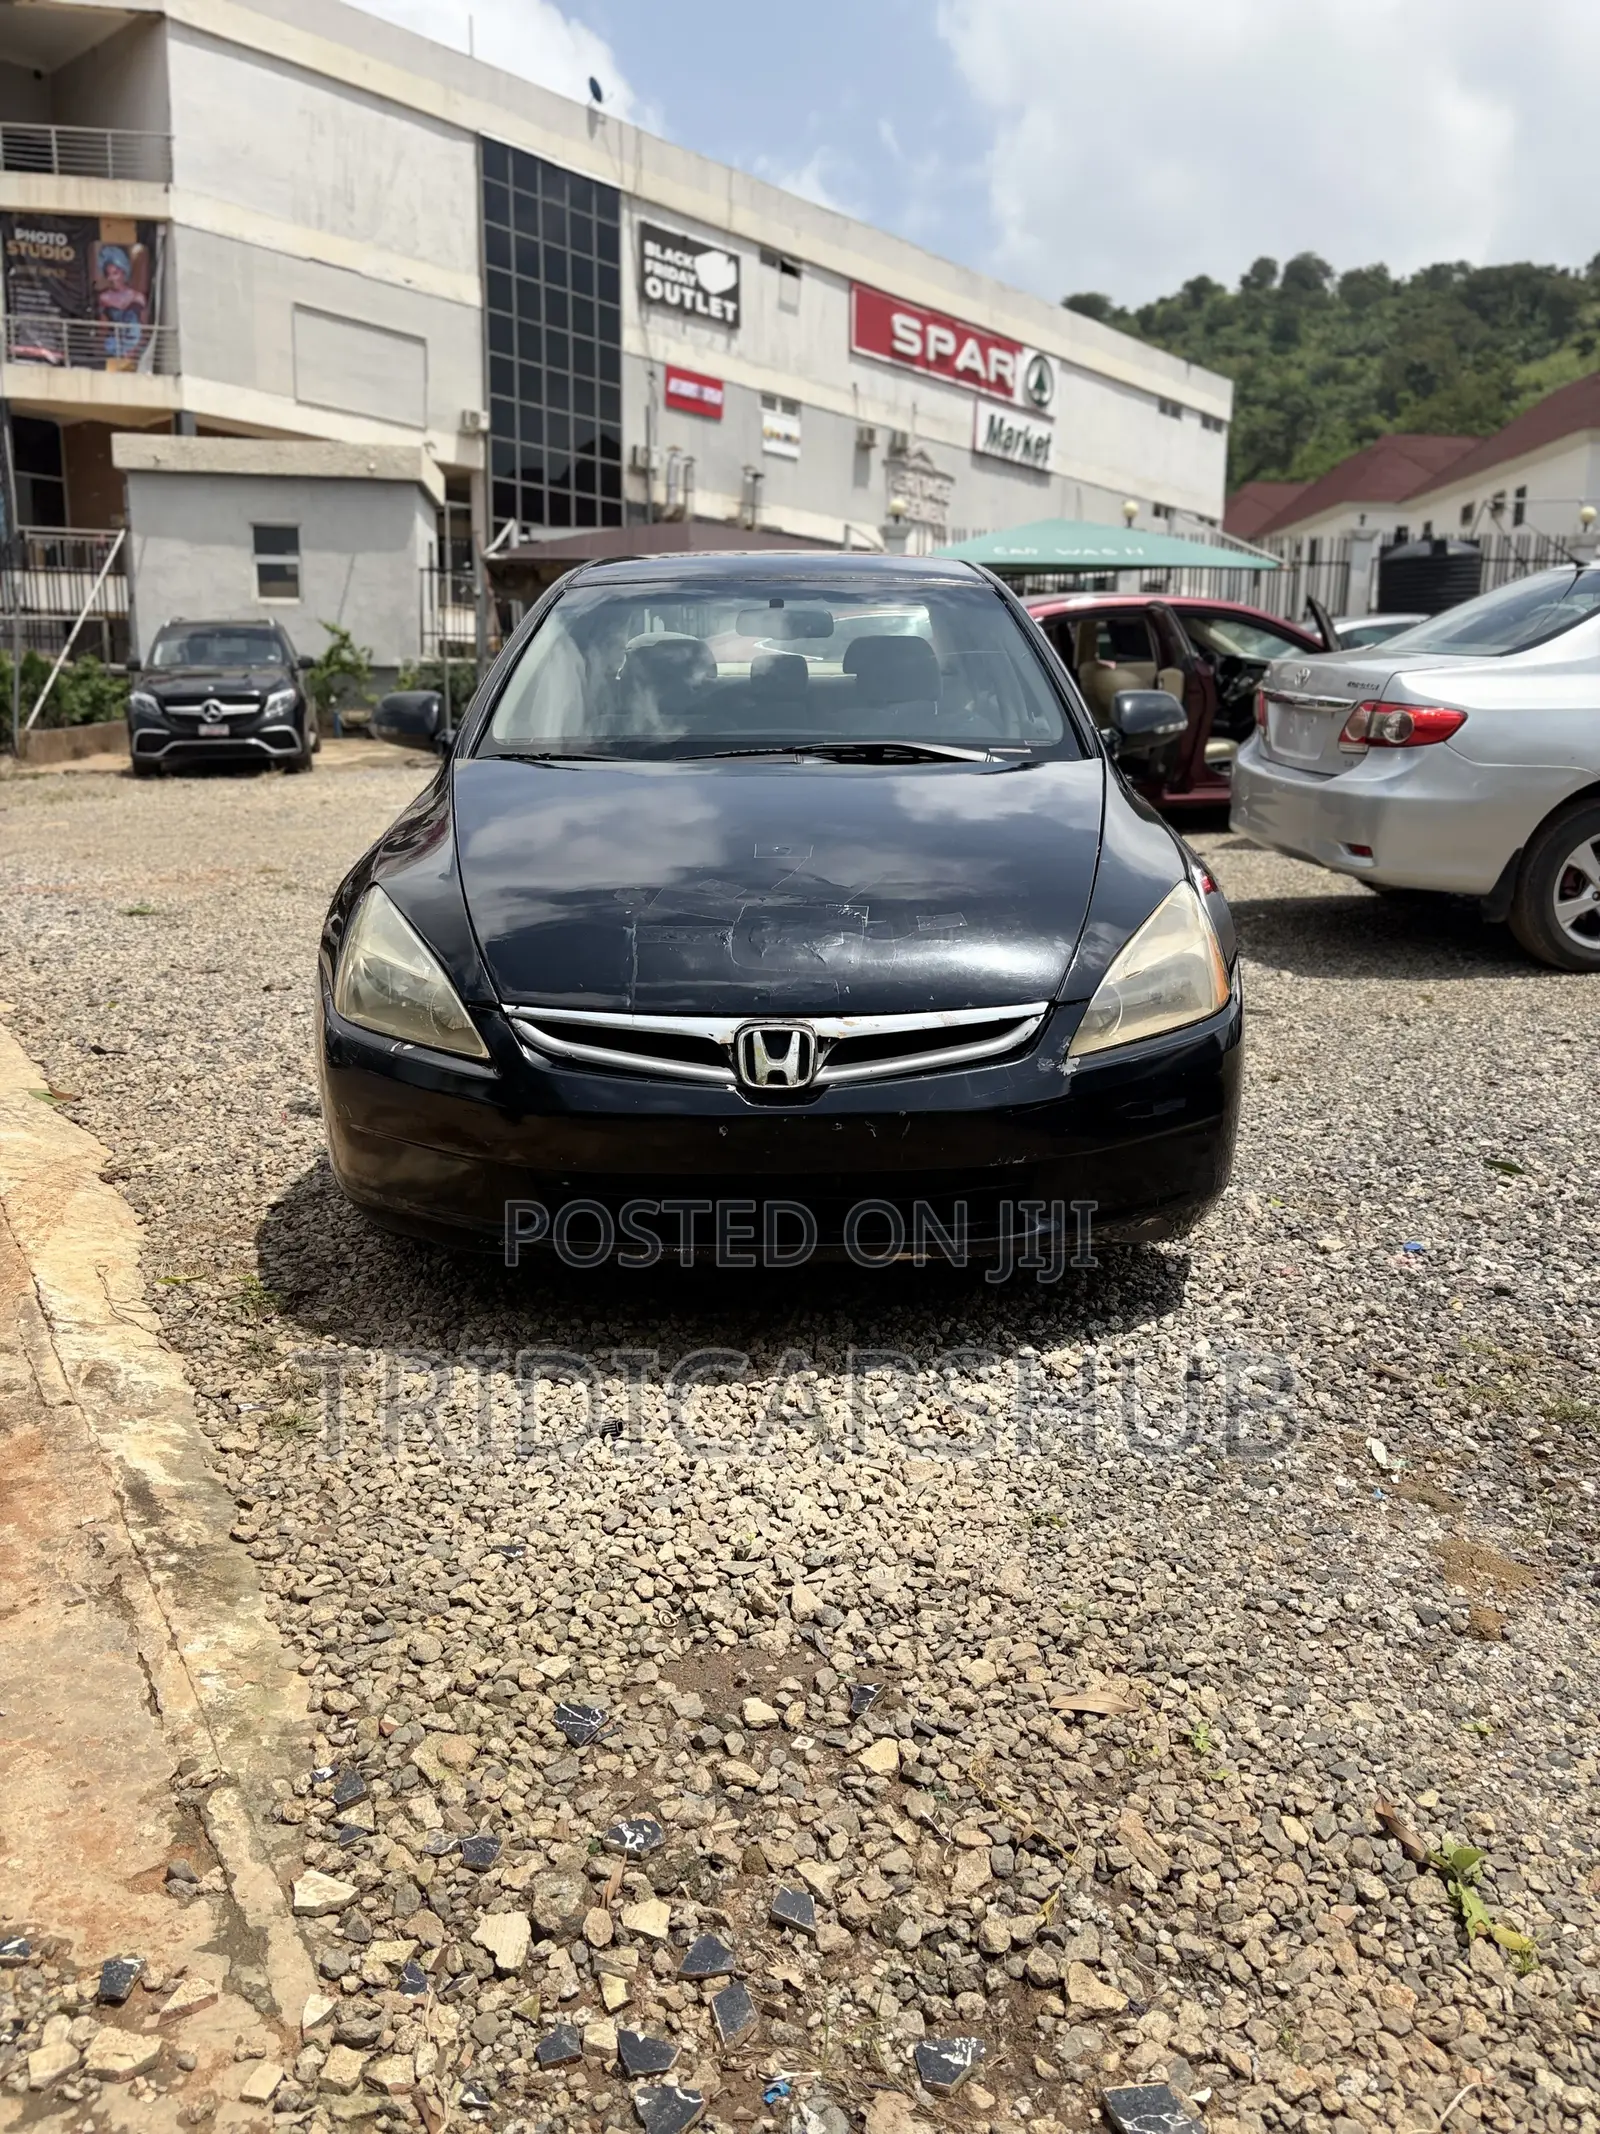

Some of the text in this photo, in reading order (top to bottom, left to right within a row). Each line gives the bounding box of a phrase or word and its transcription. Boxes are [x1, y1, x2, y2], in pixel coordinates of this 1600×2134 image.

[6, 240, 75, 261] STUDIO
[15, 228, 68, 246] PHOTO
[643, 241, 695, 268] BLACK
[643, 259, 698, 287] FRIDAY
[644, 277, 738, 322] OUTLET
[891, 312, 1014, 389] SPAR
[986, 413, 1052, 462] Market
[1055, 547, 1144, 557] WASH
